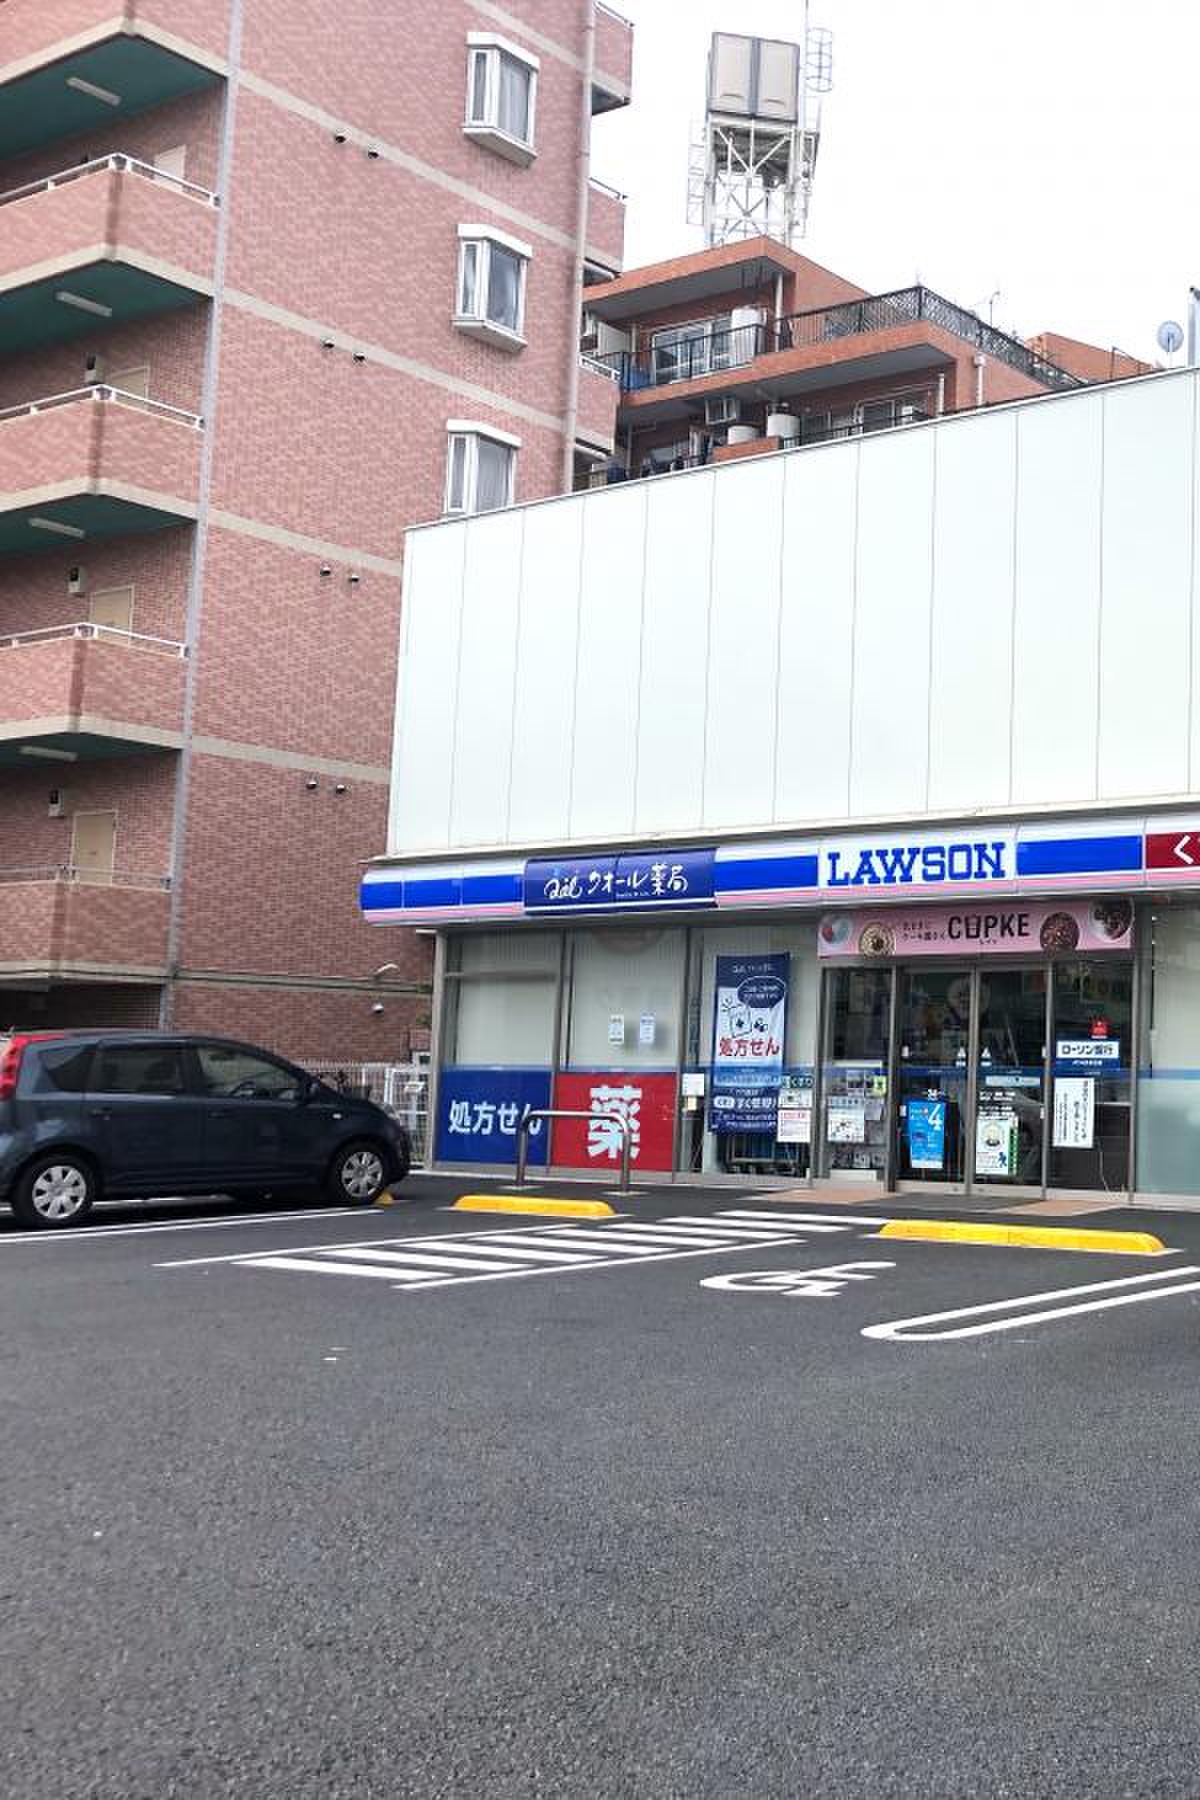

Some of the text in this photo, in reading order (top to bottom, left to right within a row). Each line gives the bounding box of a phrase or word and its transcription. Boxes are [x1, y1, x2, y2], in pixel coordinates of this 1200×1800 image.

[827, 841, 1006, 886] LAWSON
[719, 1036, 780, 1057] 処方せん
[448, 1099, 543, 1136] 処方せん
[588, 1085, 643, 1159] 薬
